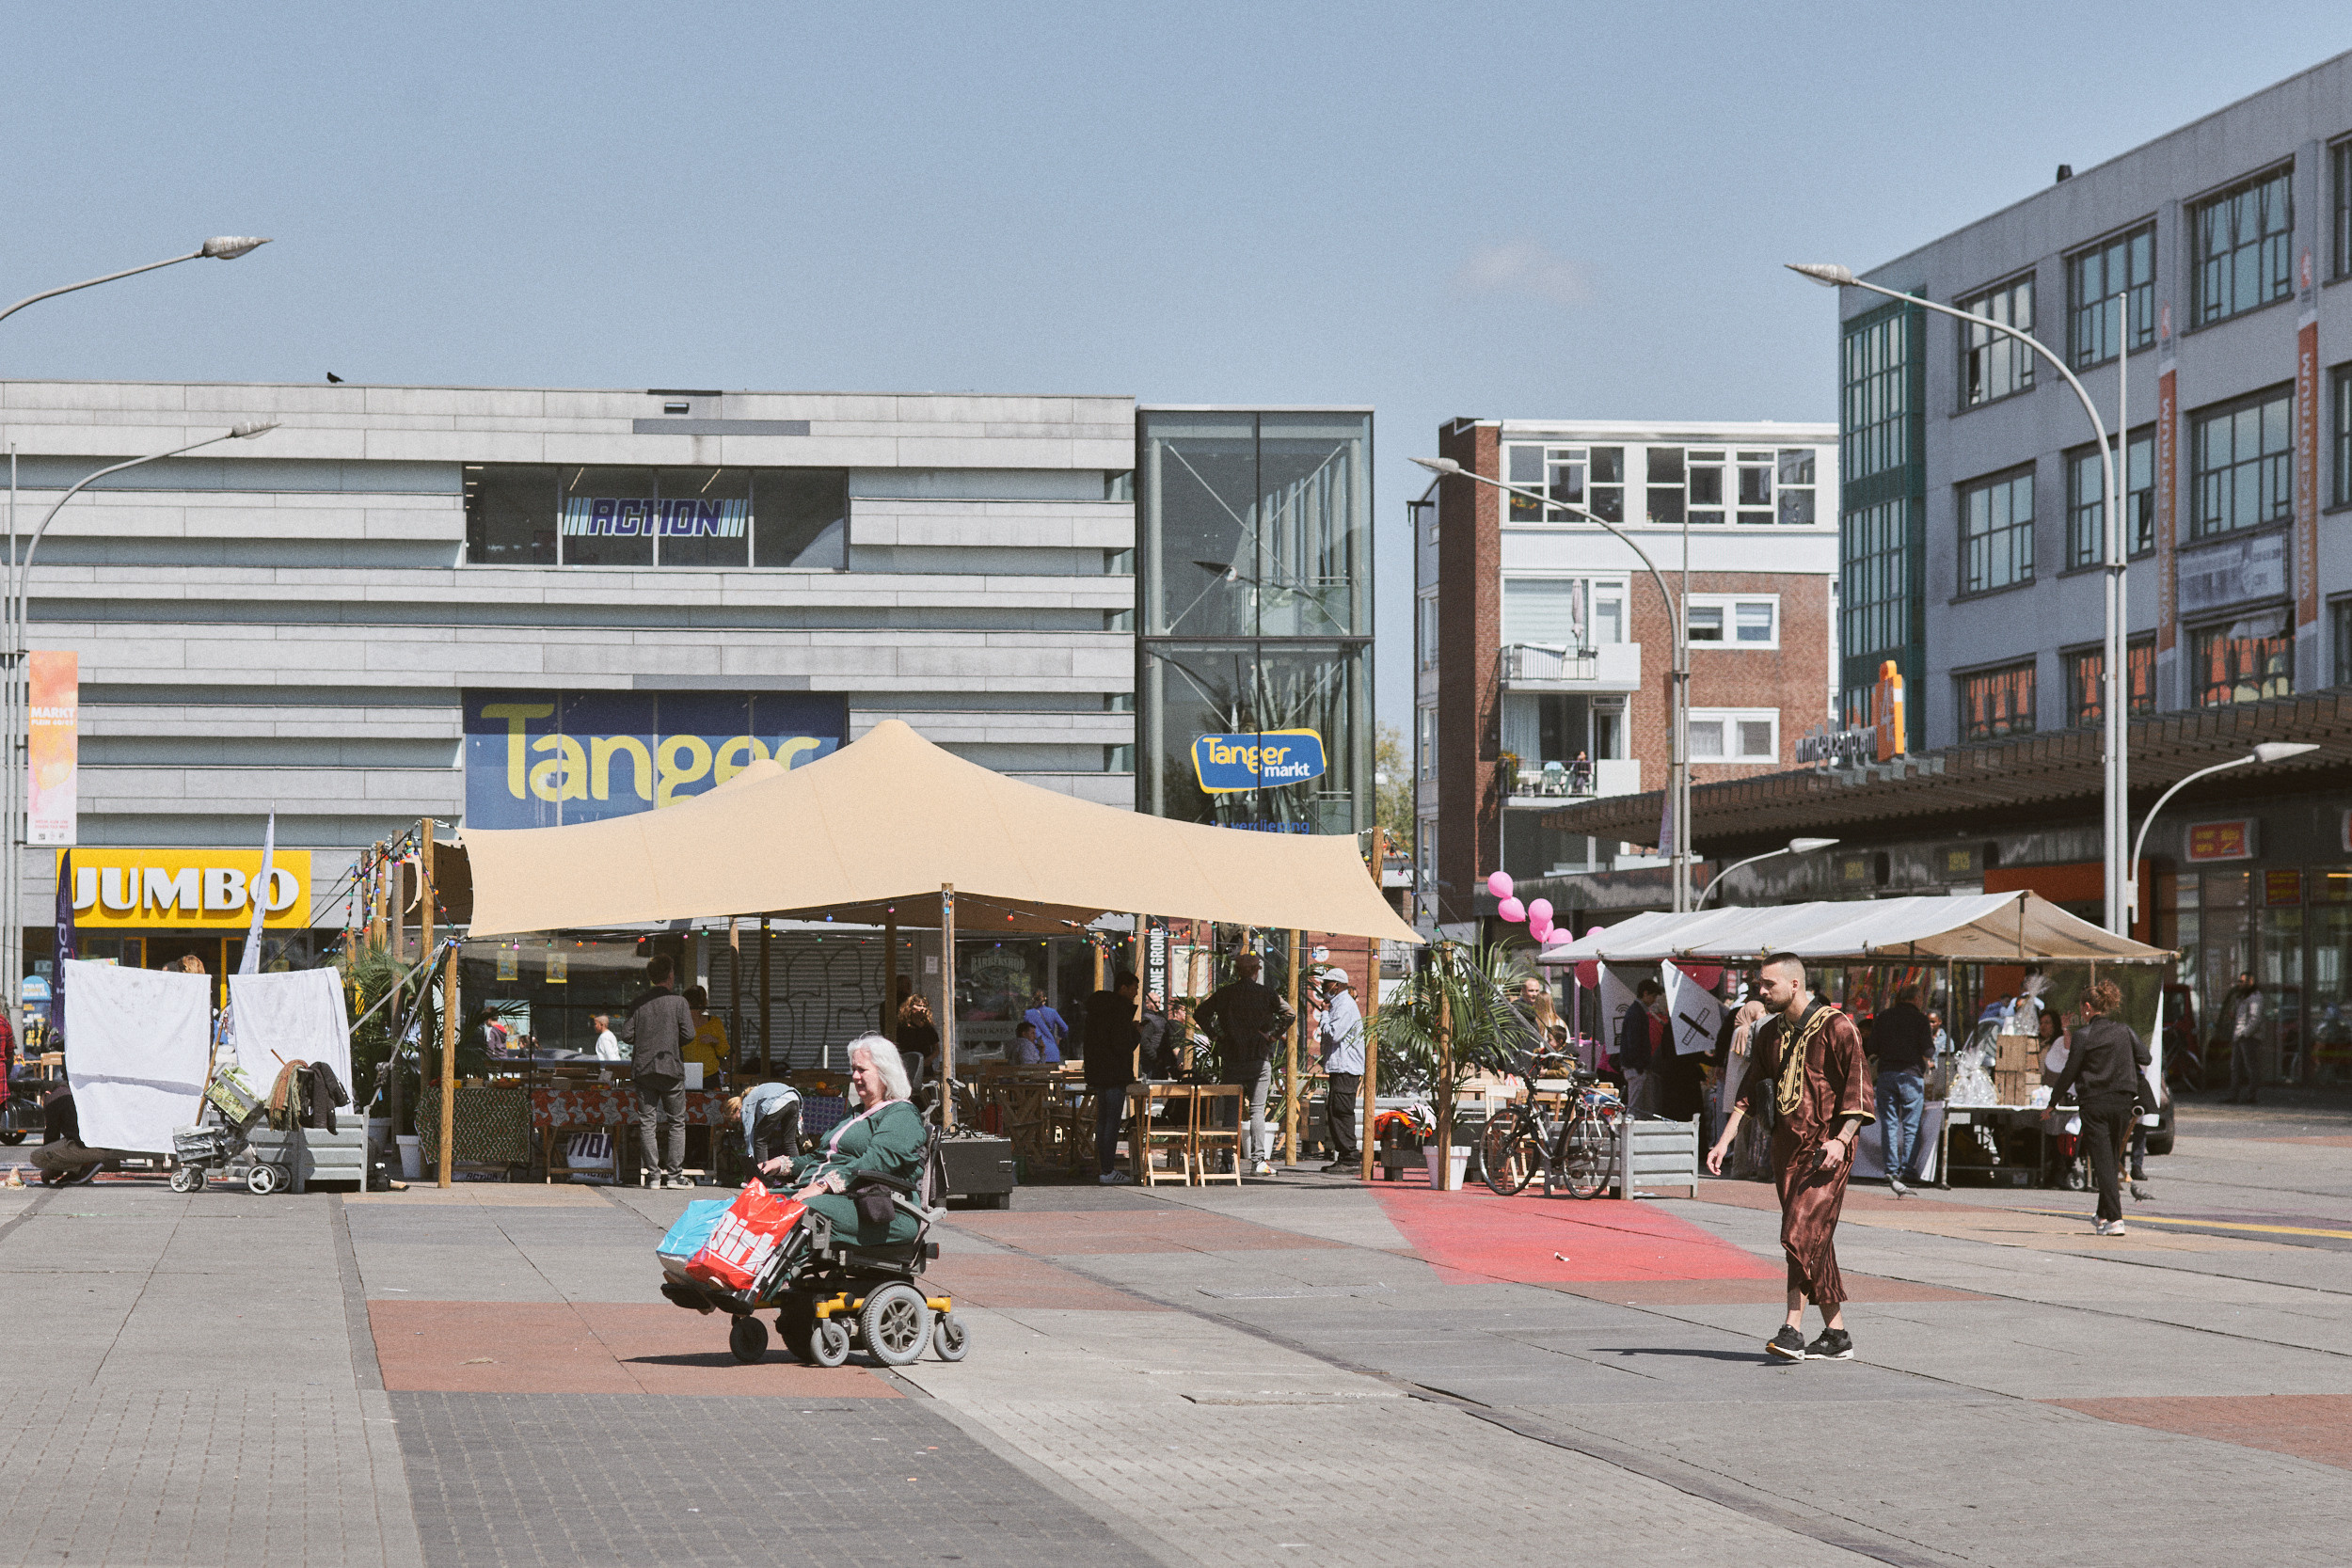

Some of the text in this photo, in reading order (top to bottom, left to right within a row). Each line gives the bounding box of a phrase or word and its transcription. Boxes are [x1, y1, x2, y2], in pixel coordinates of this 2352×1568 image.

[588, 498, 723, 537] ACTION
[31, 706, 75, 719] MARKT
[1202, 737, 1292, 774] Tanger
[1264, 761, 1311, 777] markt
[72, 867, 299, 911] JUMBO
[1150, 927, 1165, 966] GROND
